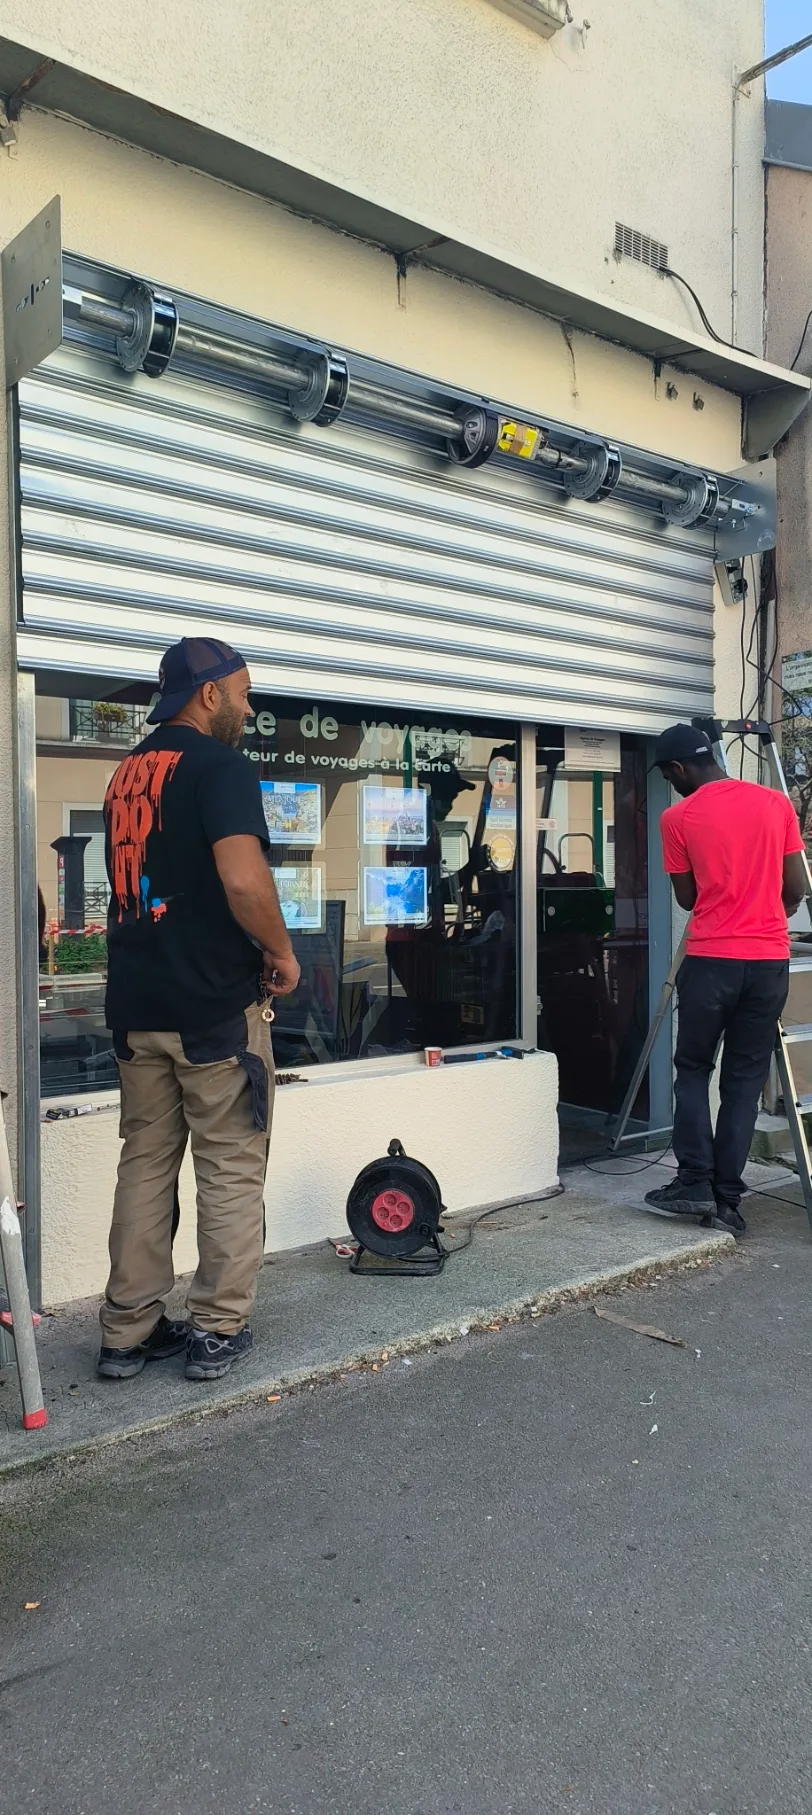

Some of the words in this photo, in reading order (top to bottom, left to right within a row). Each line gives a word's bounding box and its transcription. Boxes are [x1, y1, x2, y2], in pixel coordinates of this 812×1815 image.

[300, 706, 339, 740] de
[361, 720, 472, 758] voyages
[284, 750, 306, 764] de
[311, 755, 376, 771] voyages
[380, 757, 390, 770] à
[395, 757, 410, 771] la
[415, 763, 451, 773] carte
[112, 795, 153, 846] DO
